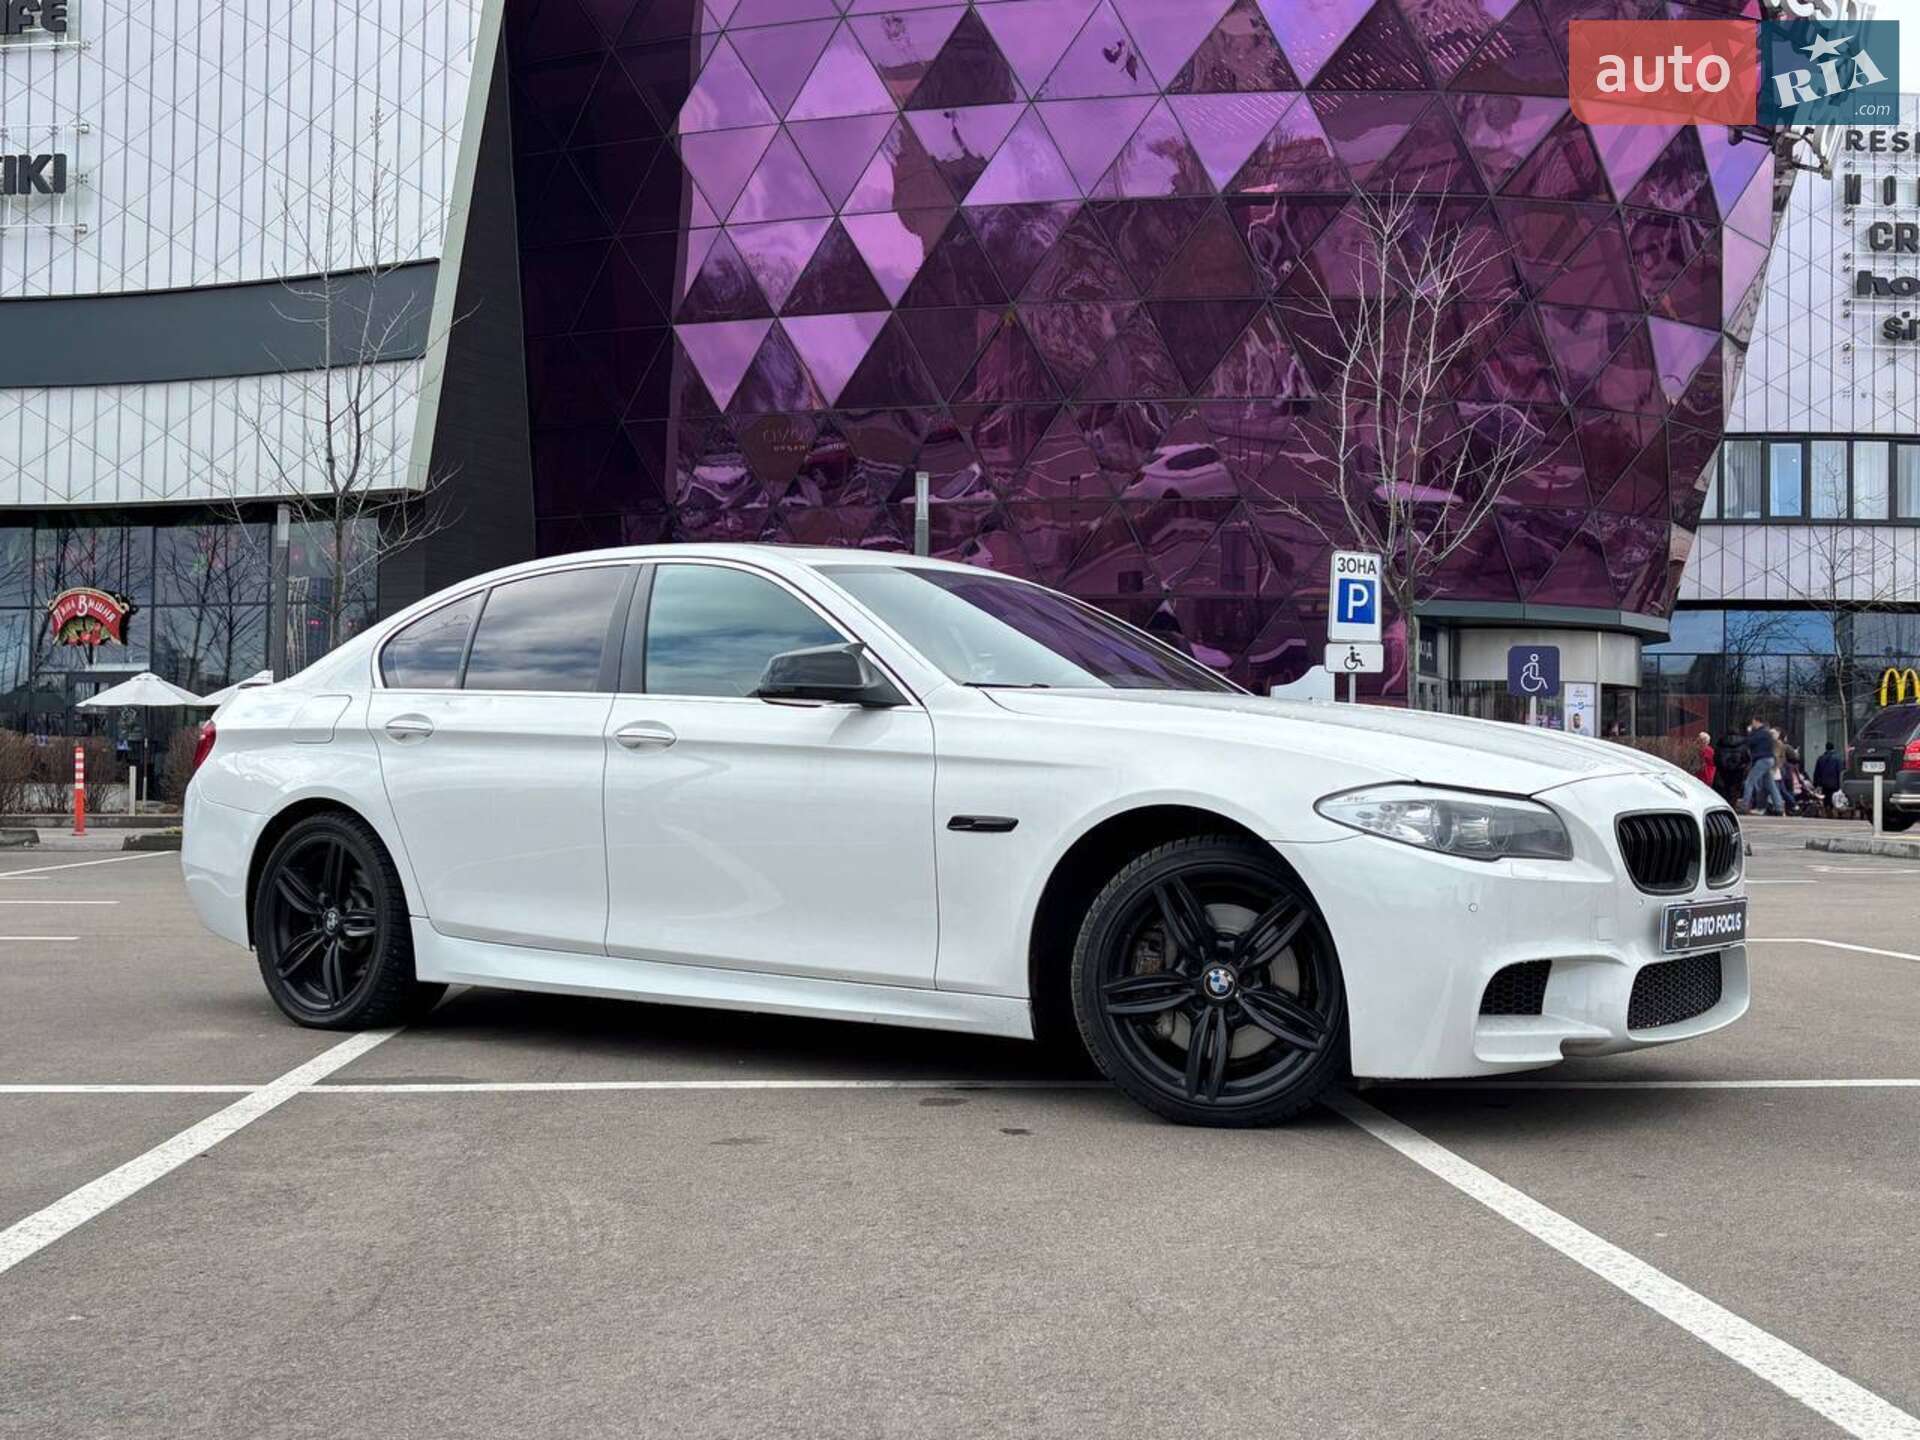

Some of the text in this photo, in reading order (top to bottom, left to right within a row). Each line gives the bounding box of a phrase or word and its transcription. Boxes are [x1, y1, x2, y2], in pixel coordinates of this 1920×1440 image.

[1845, 129, 1920, 152] RES
[0, 153, 67, 195] IKI
[1844, 174, 1920, 206] MO
[1868, 221, 1920, 253] CR
[1857, 270, 1920, 296] ho
[1337, 557, 1377, 575] ЗОНА
[1347, 583, 1369, 619] P
[1715, 912, 1742, 934] FOCUS
